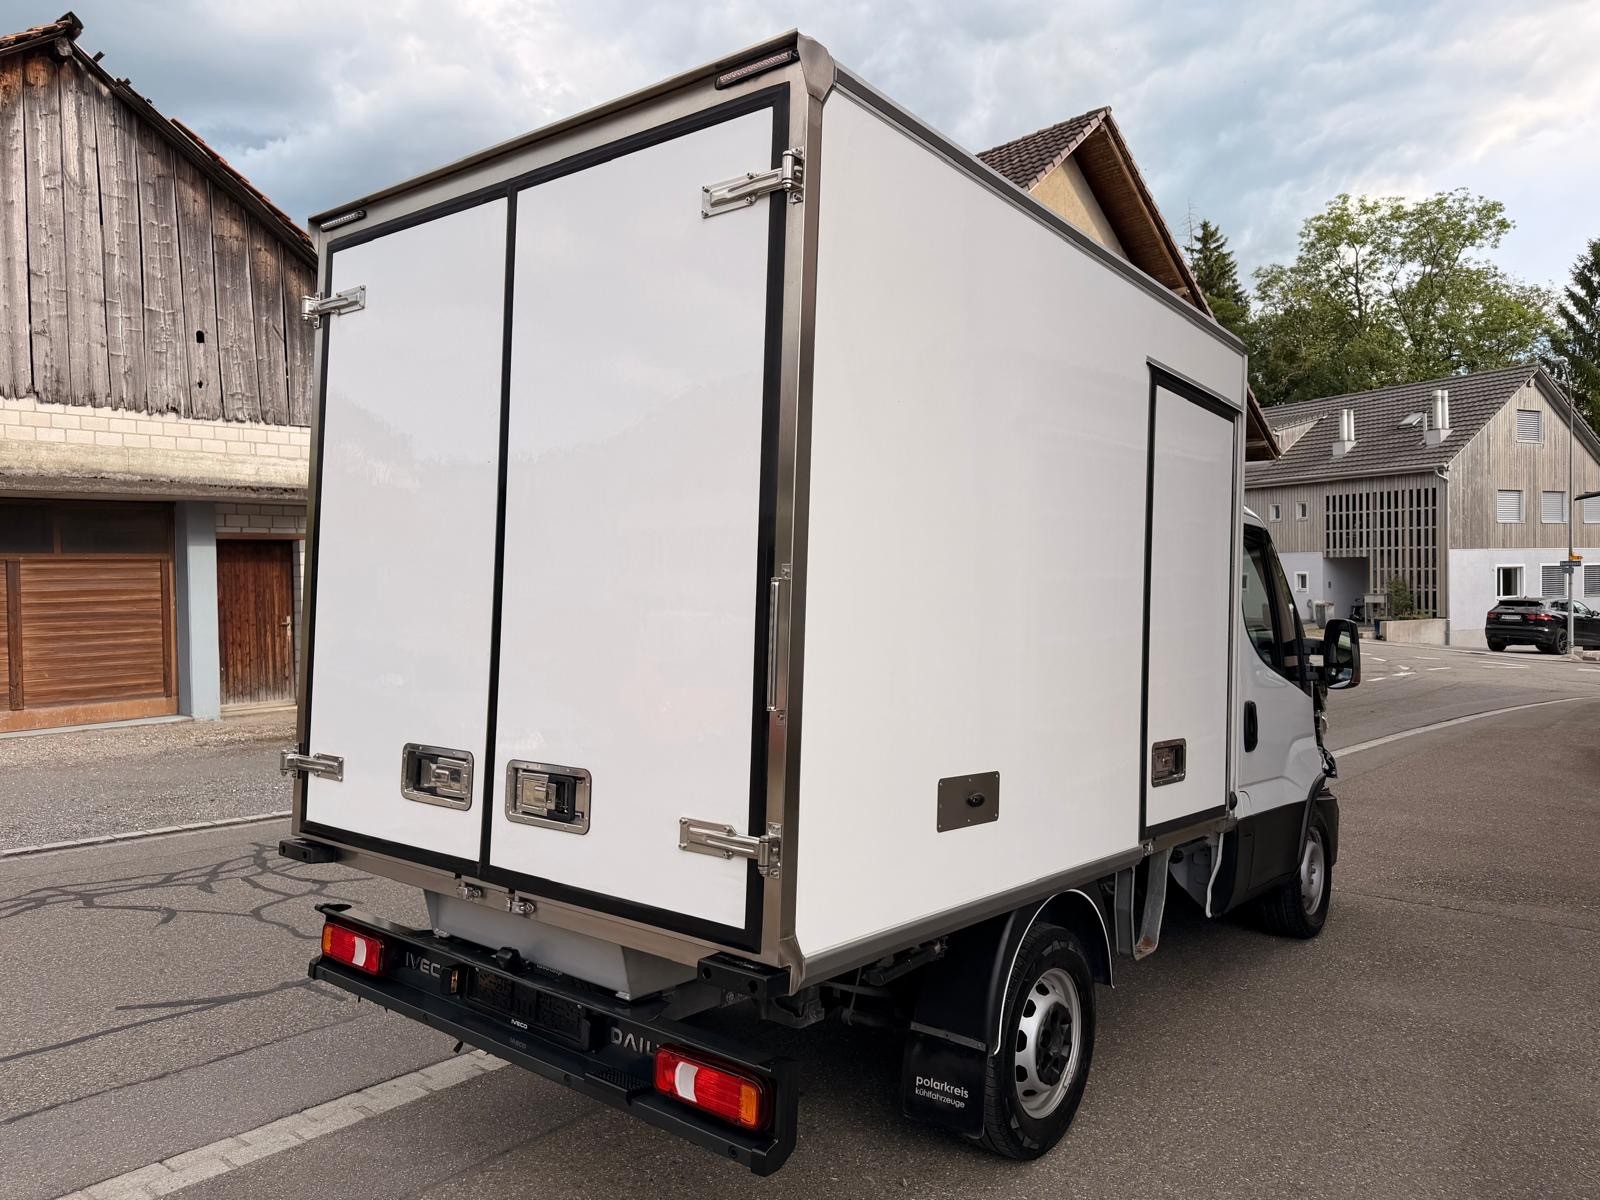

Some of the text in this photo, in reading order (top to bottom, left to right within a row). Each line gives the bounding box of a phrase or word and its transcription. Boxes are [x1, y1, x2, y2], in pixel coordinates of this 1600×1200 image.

[405, 951, 442, 979] IVEC
[610, 1026, 660, 1056] DAIL
[915, 1075, 969, 1099] polarkreis
[915, 1087, 966, 1108] kühlfahrzeuge
